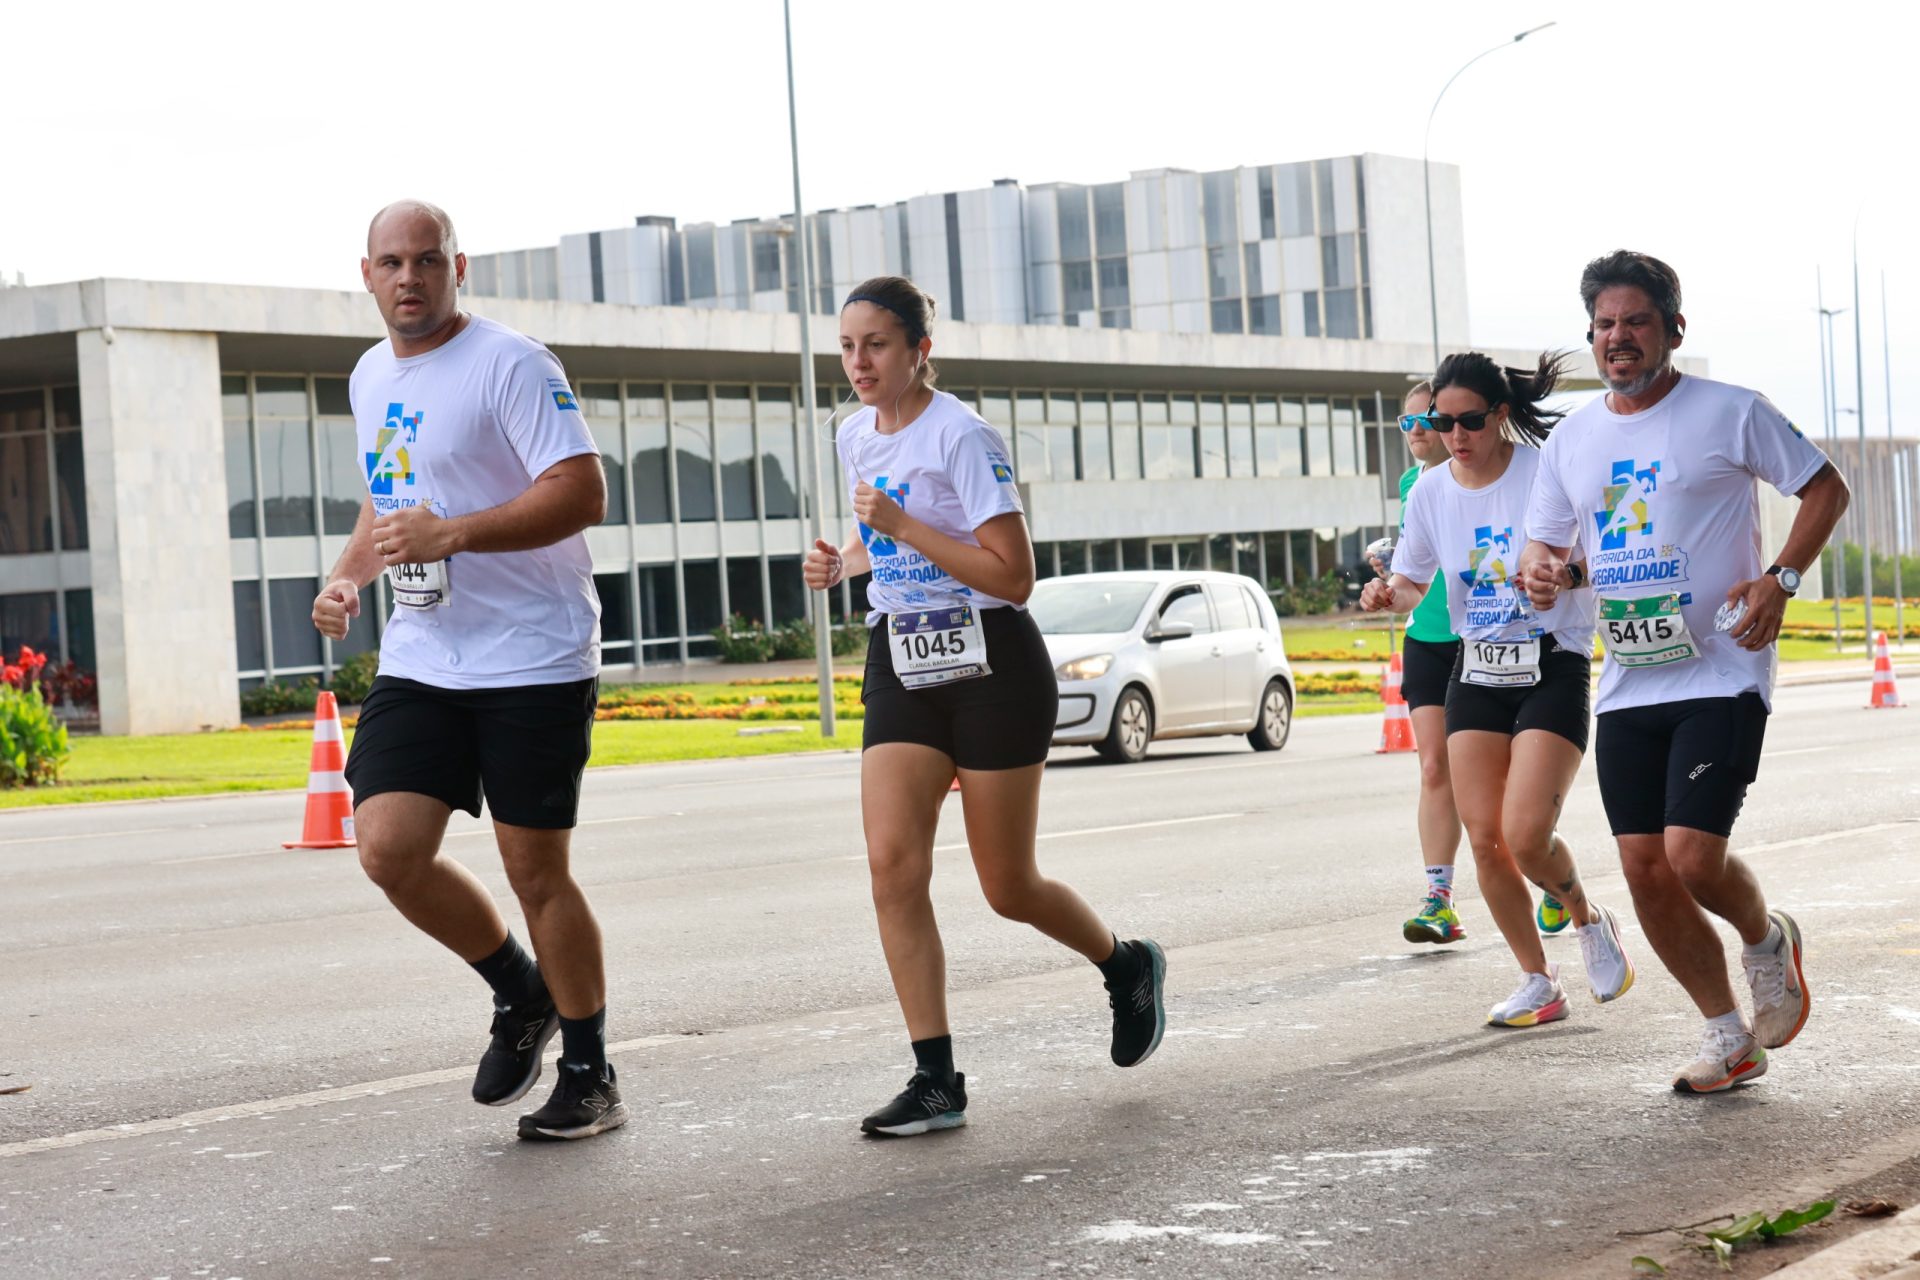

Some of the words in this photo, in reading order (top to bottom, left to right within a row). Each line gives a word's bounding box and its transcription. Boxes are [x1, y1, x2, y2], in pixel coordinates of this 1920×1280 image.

[1636, 547, 1656, 561] DA
[391, 562, 427, 582] 1044
[1608, 618, 1673, 644] 5415
[901, 630, 966, 660] 1045
[1474, 642, 1520, 665] 1071
